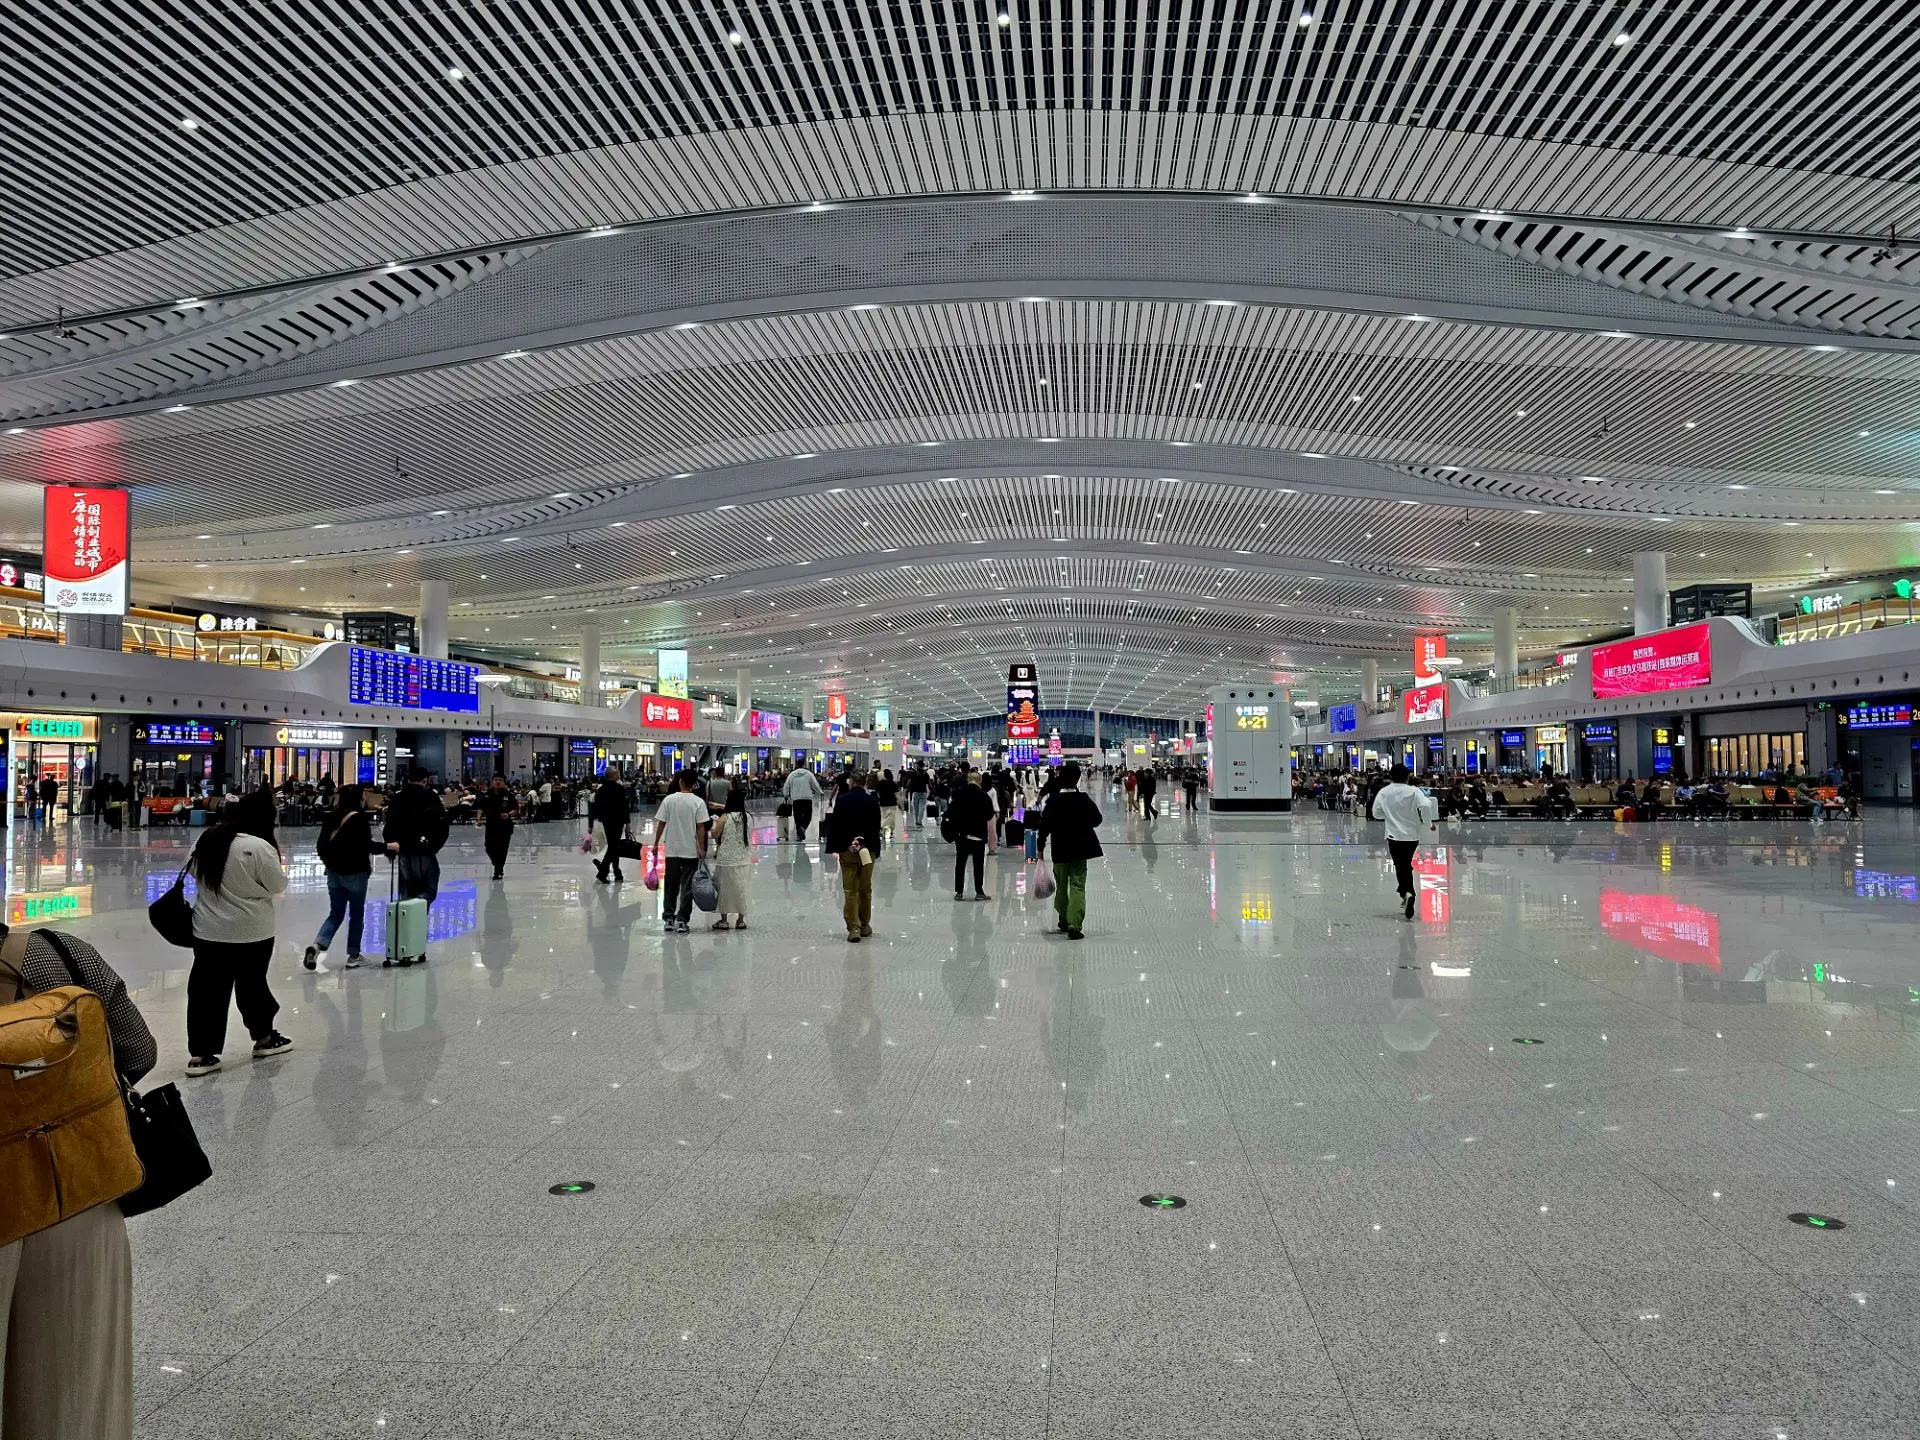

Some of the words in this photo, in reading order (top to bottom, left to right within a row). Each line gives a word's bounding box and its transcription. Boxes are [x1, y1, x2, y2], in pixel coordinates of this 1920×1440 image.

[87, 504, 102, 574] 国际创业城市
[1238, 716, 1267, 729] 4-21
[136, 728, 146, 739] 2A
[214, 731, 223, 741] 3A
